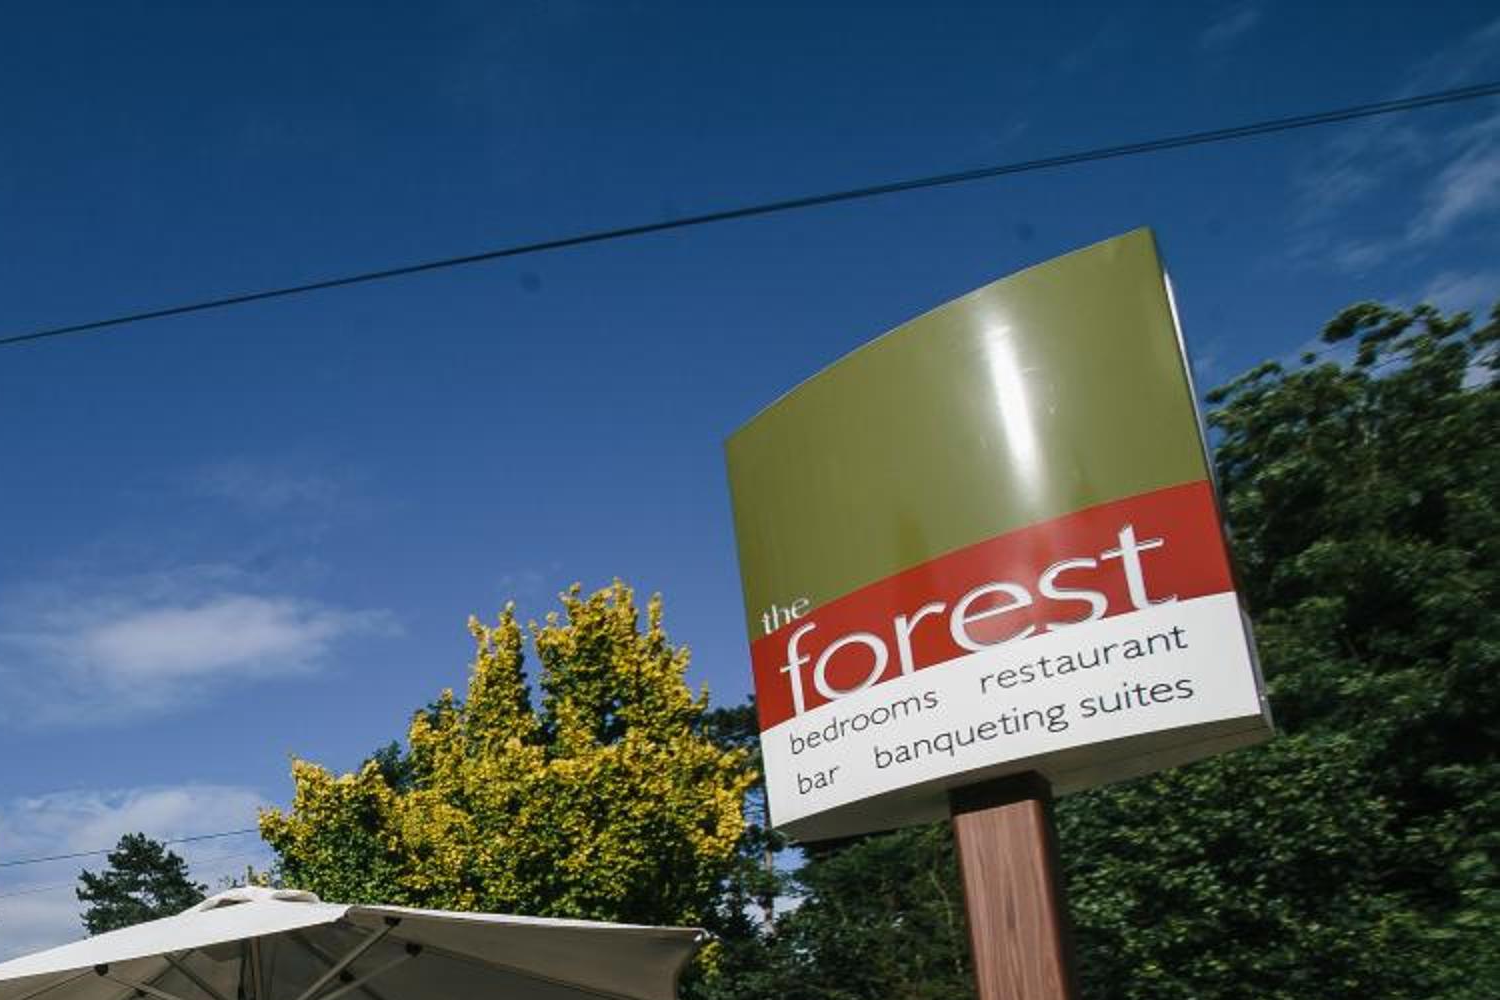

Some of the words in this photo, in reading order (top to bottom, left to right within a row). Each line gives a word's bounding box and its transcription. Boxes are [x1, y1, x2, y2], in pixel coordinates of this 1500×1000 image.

[761, 596, 811, 635] the
[779, 524, 1178, 715] forest
[788, 690, 939, 755] bedrooms
[980, 625, 1190, 693] restaurant
[797, 765, 841, 795] bar
[874, 702, 1070, 770] banqueting
[1080, 675, 1194, 719] suites
